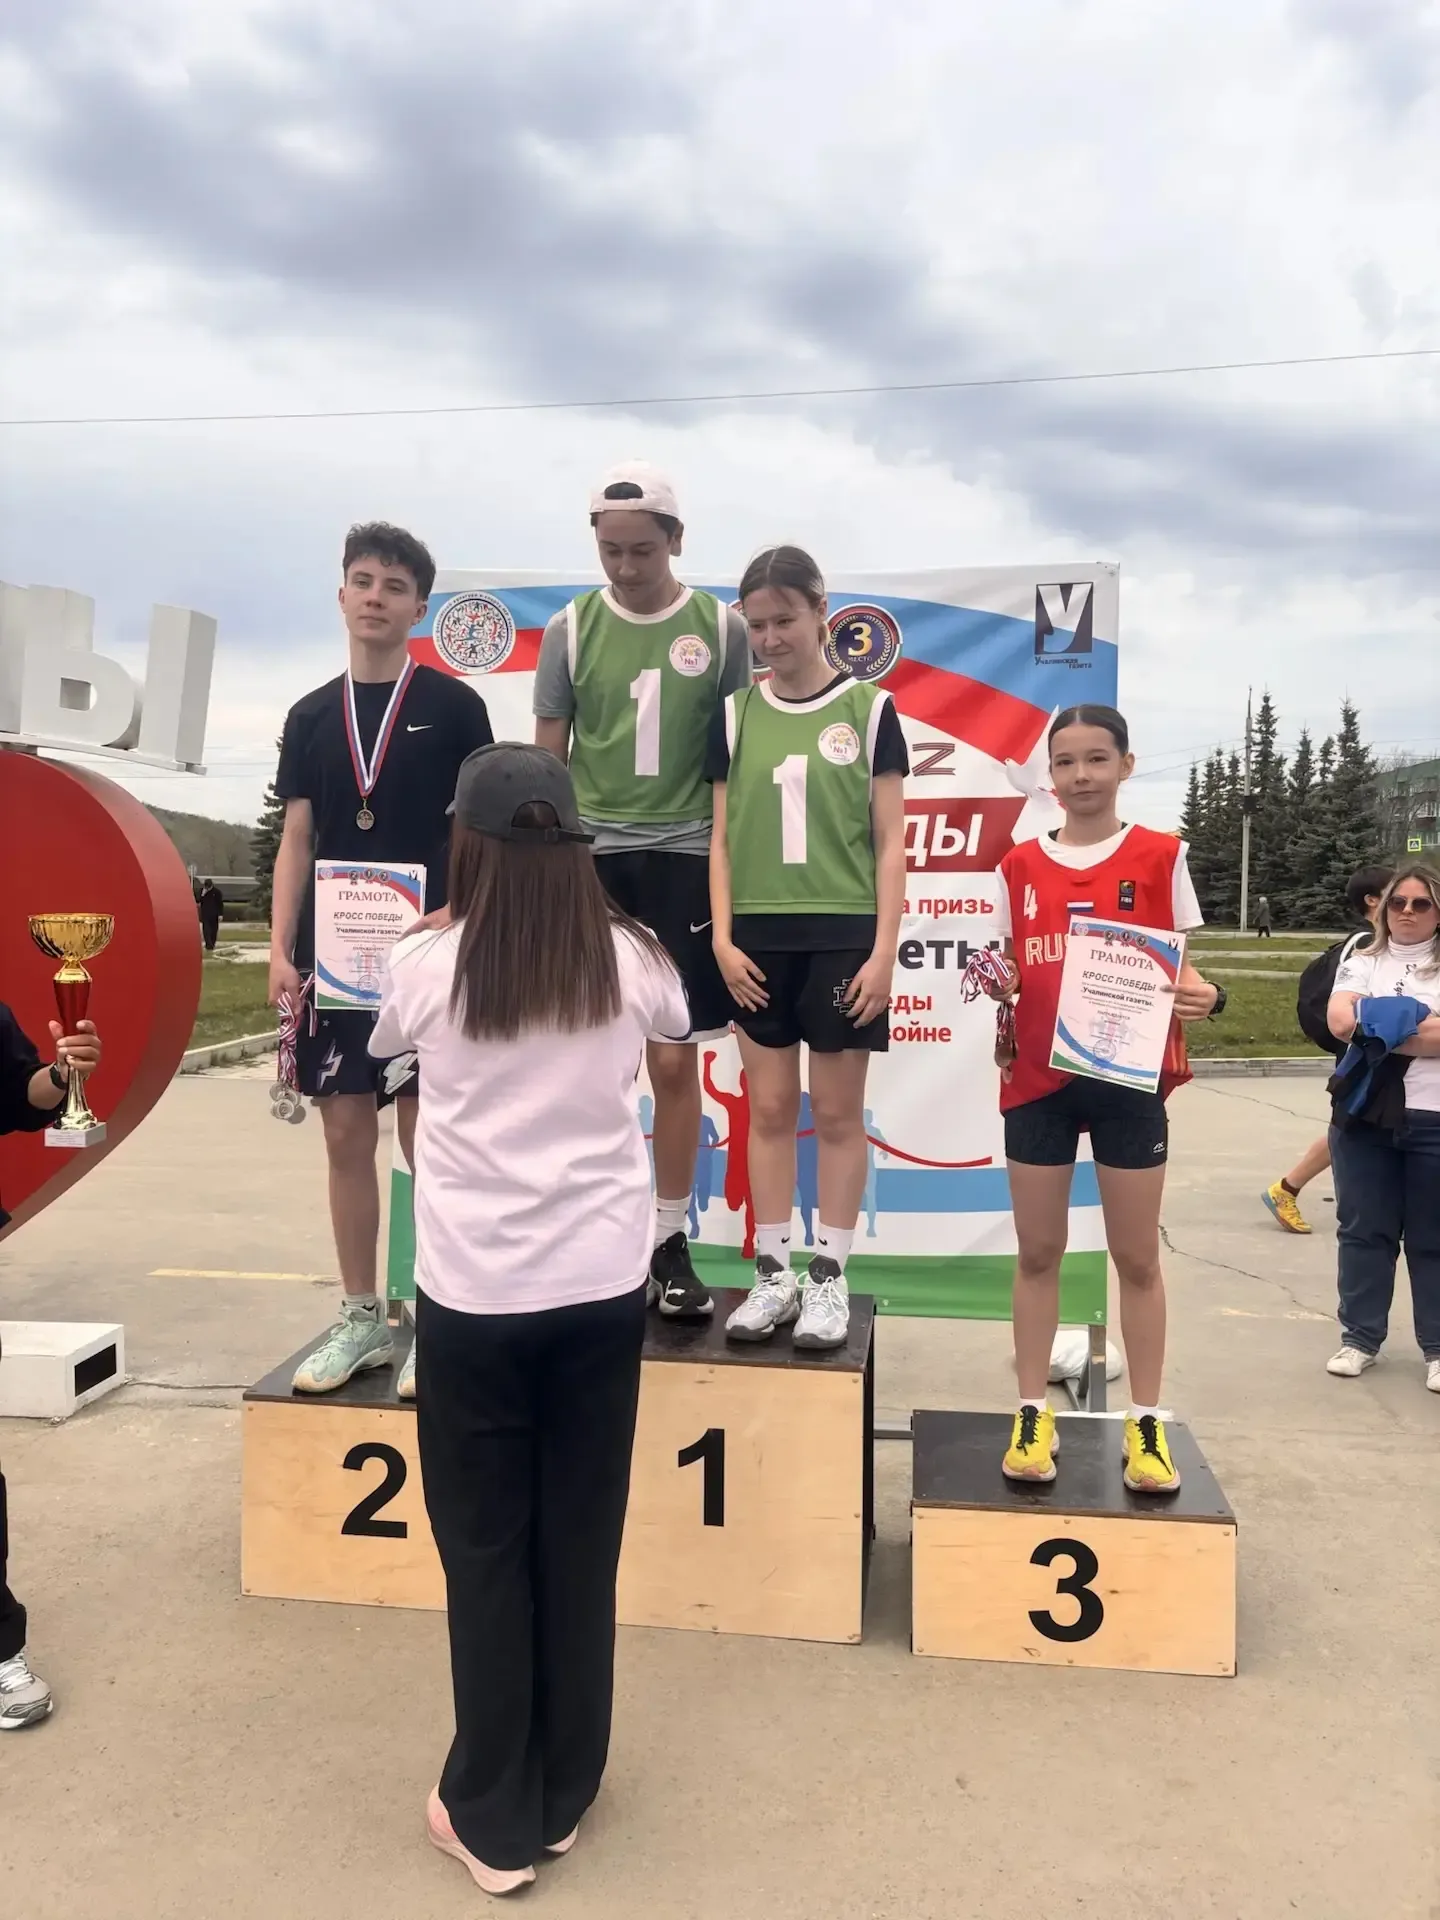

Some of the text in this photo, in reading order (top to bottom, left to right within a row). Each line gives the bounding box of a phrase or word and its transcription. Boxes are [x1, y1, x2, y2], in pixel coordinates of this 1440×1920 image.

[848, 621, 873, 657] 3
[0, 580, 218, 765] Ы
[630, 668, 661, 776] 1
[773, 754, 808, 864] 1
[338, 890, 399, 902] ГРАМОТА
[1023, 883, 1038, 920] 4
[333, 912, 403, 922] КРОСС ПОБЕДЫ
[1025, 932, 1070, 966] RU
[1090, 949, 1154, 971] ГРАМОТА
[1082, 970, 1114, 983] КРОСС
[1115, 977, 1156, 992] ПОБЕДЫ
[887, 1021, 952, 1042] ойне
[341, 1442, 408, 1538] 2
[678, 1428, 725, 1527] 1
[1028, 1538, 1104, 1642] 3
